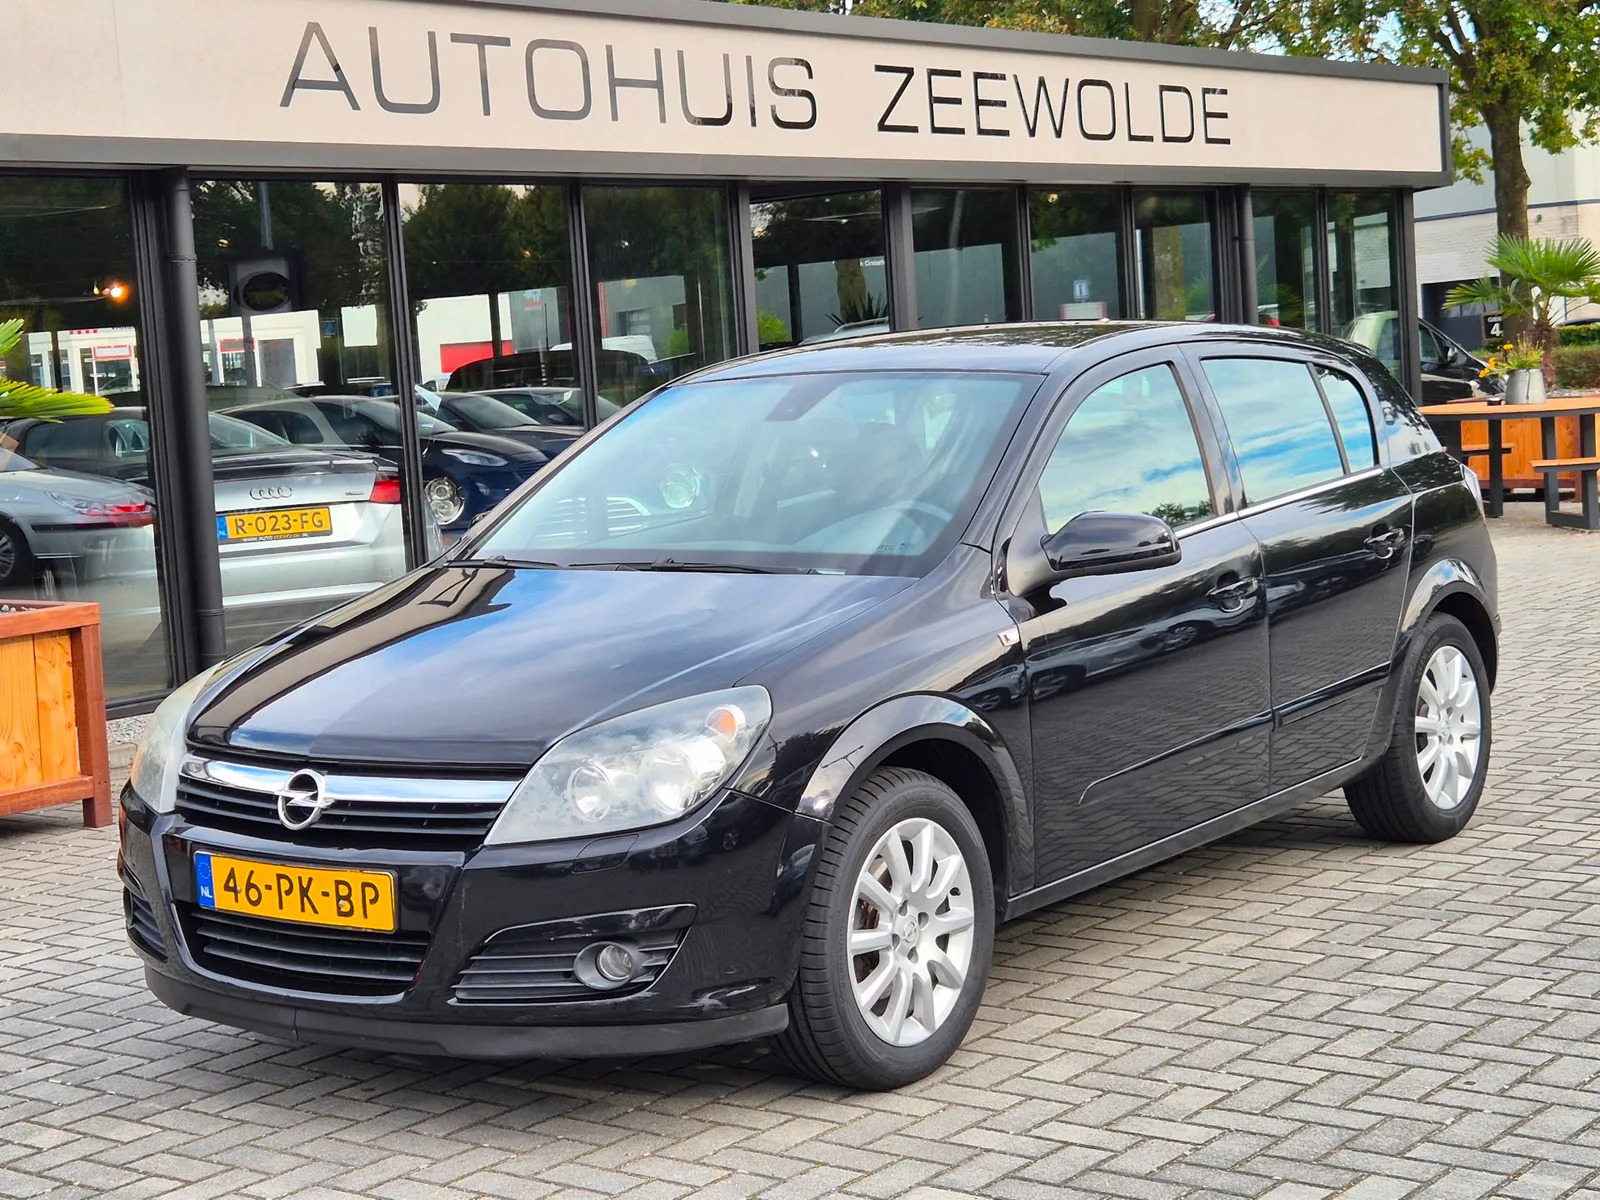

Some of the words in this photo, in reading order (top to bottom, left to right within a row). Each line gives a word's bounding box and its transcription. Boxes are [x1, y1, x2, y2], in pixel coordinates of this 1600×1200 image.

[280, 21, 818, 131] AUTOHUIS
[874, 64, 1231, 145] ZEEWOLDE
[1490, 322, 1504, 337] 4
[234, 512, 324, 535] R-023-FG
[200, 885, 213, 899] NL
[223, 867, 380, 920] 46-PK-BP
